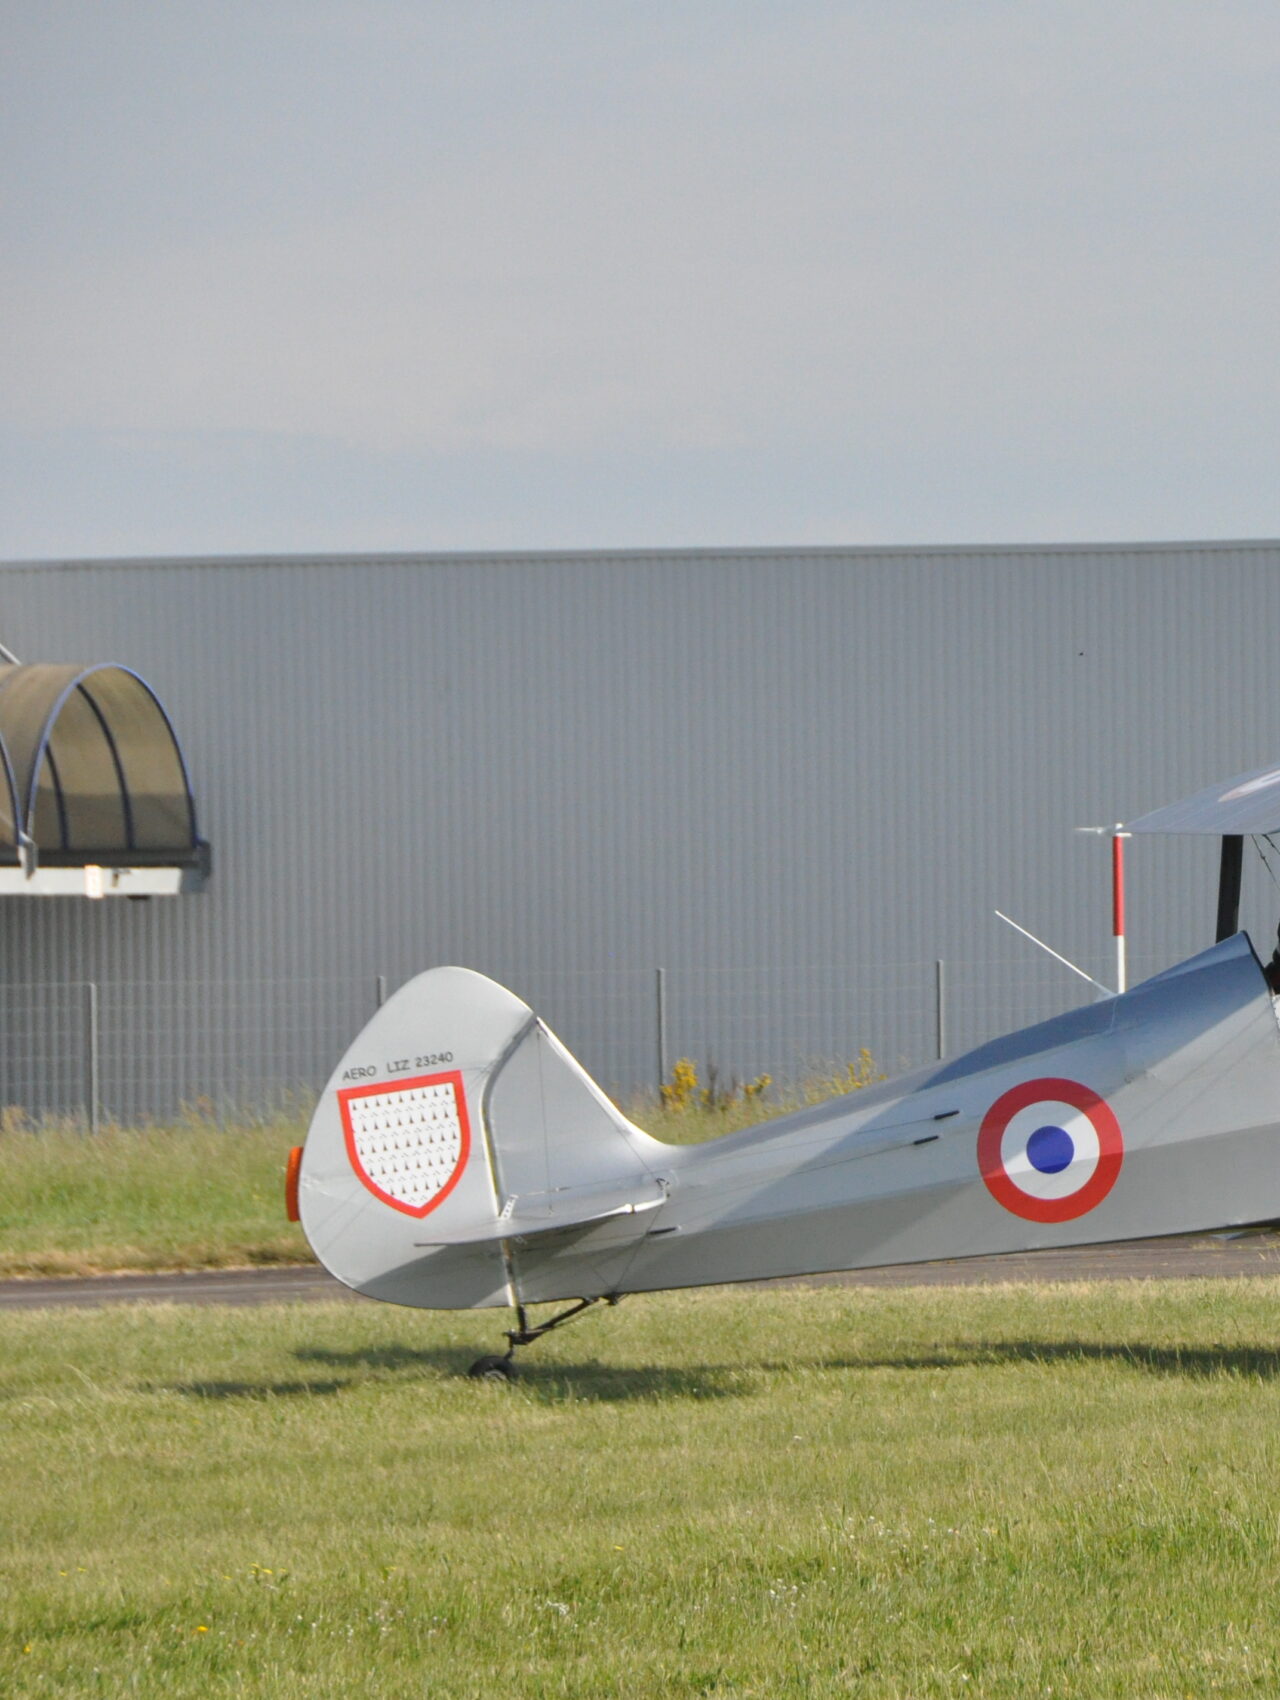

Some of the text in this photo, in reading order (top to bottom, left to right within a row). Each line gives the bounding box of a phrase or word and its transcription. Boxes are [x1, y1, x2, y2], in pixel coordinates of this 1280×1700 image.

[343, 1051, 454, 1080] AERO LIZ 23240
